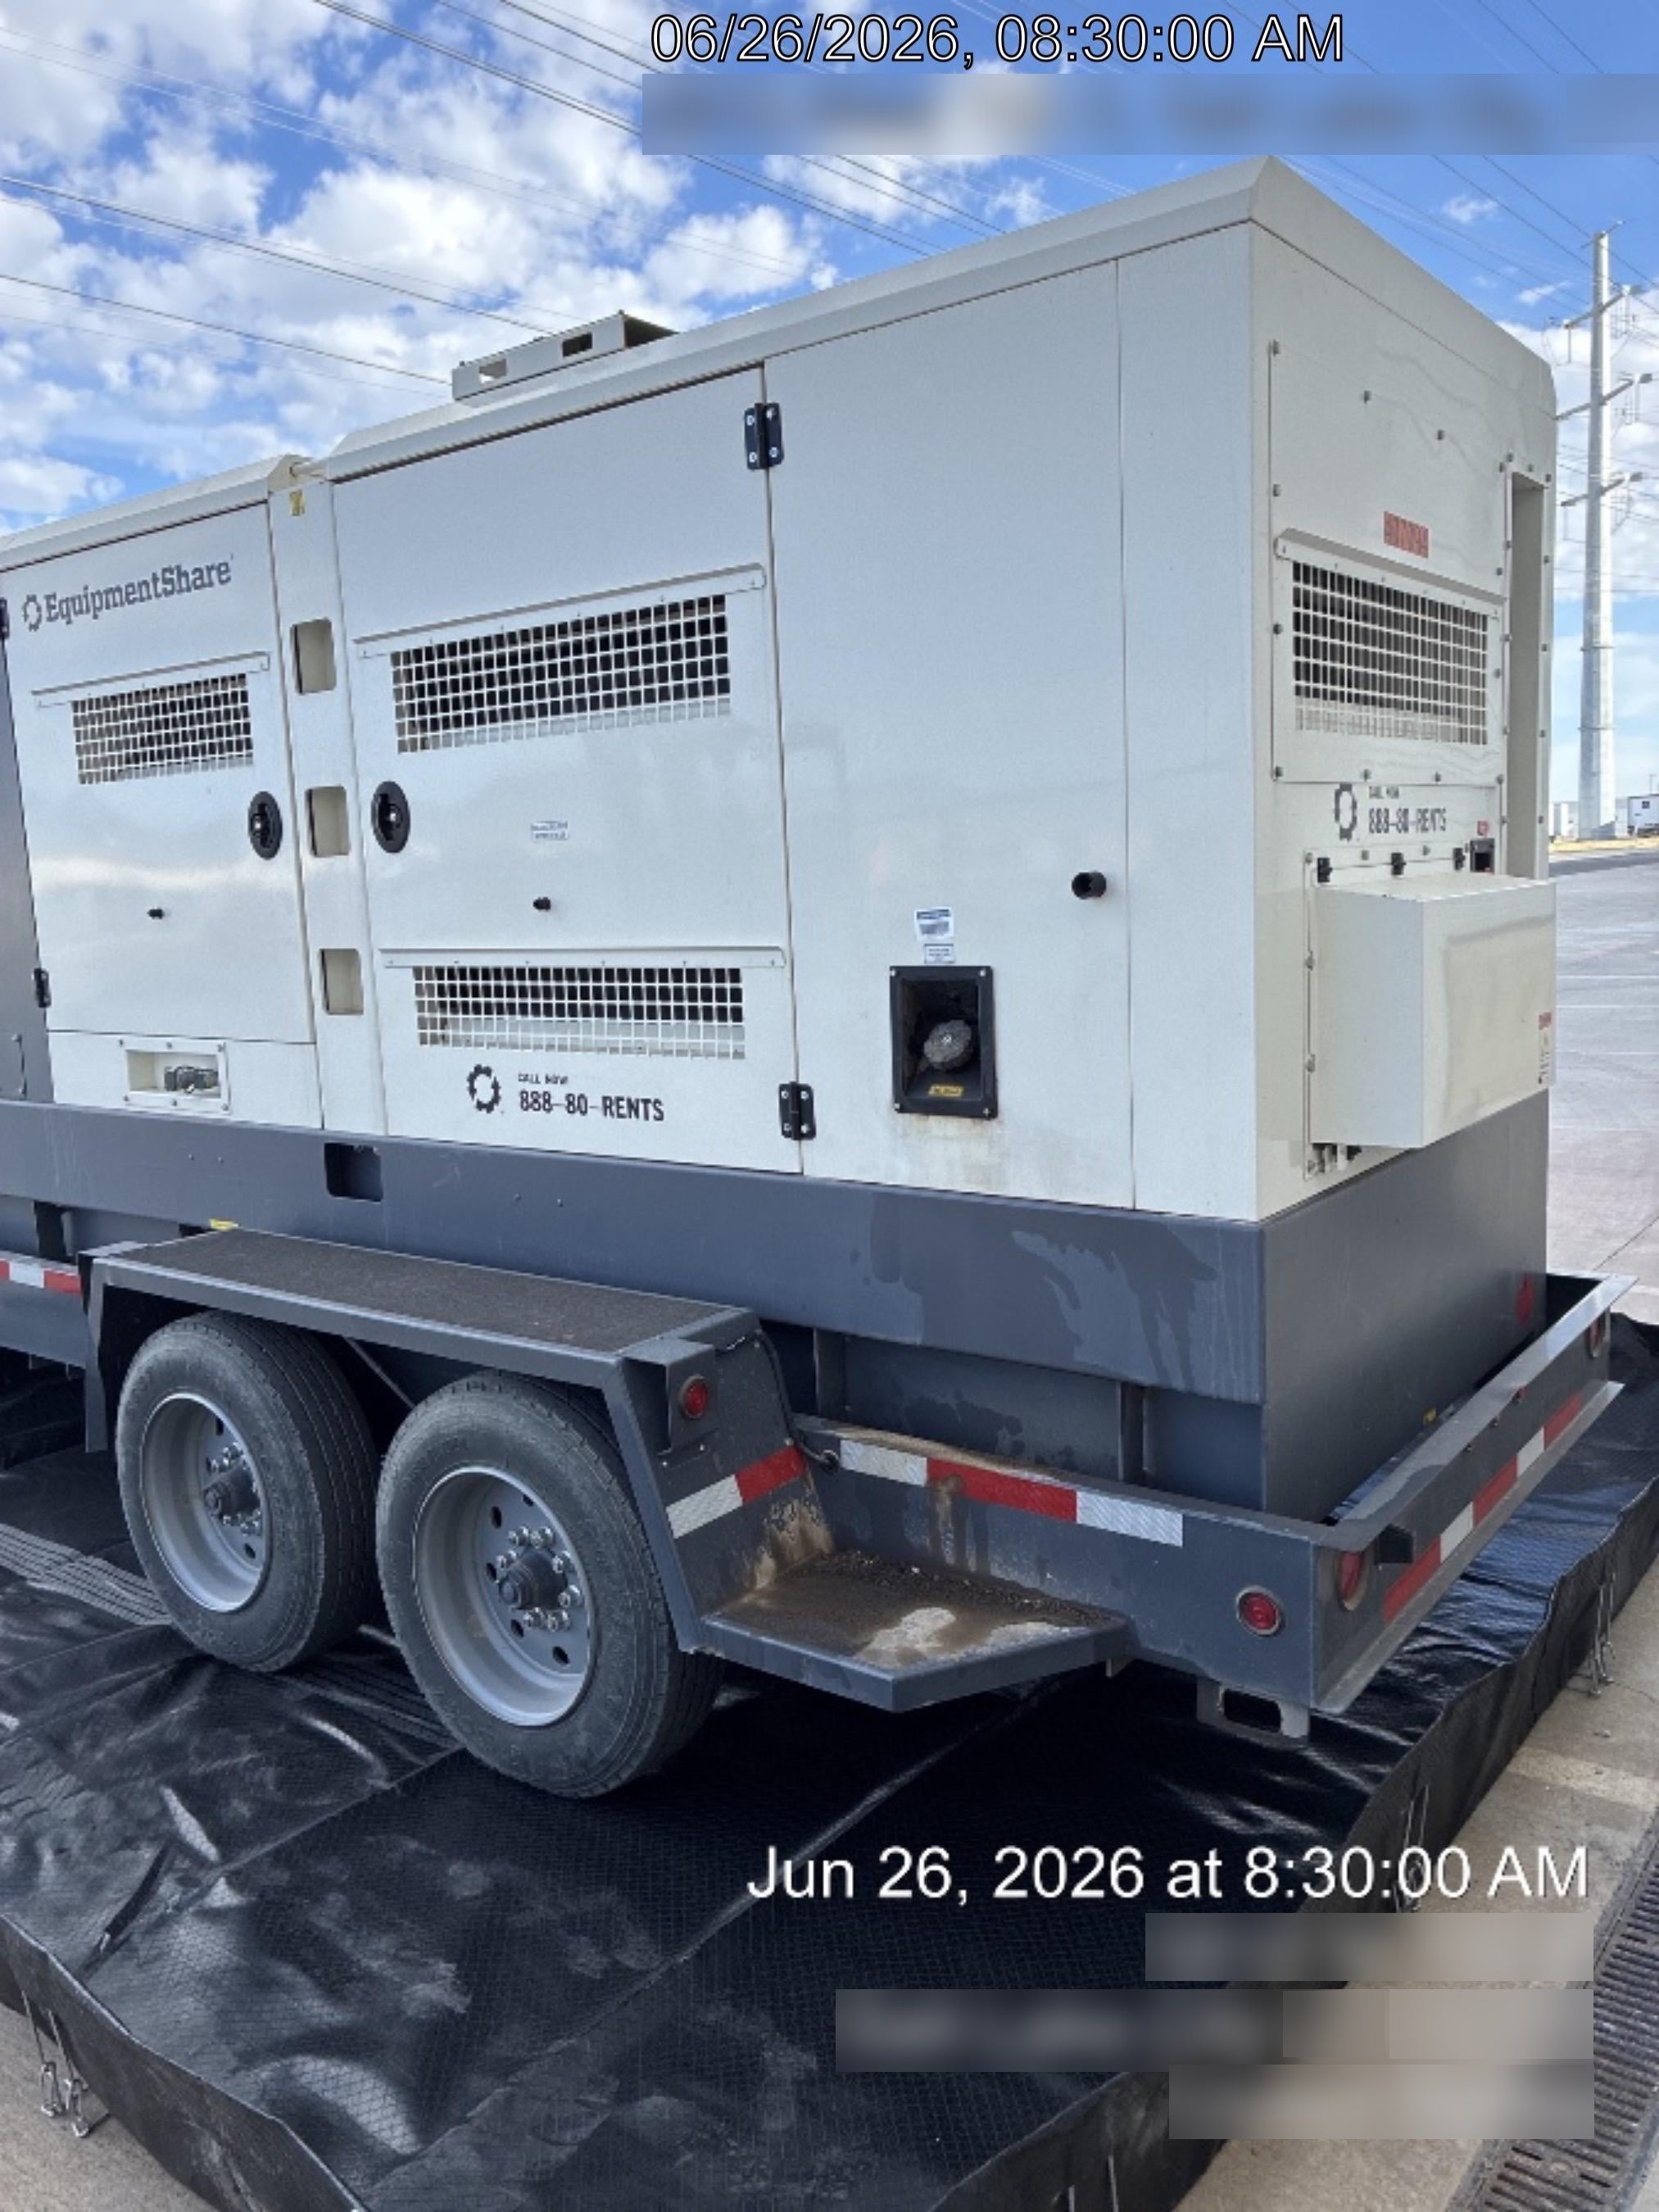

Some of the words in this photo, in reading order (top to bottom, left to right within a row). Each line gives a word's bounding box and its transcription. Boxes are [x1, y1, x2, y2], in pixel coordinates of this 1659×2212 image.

[43, 560, 233, 625] EquipmentShare
[518, 1072, 542, 1085] CALL
[519, 1089, 665, 1122] 888-80-RENTS
